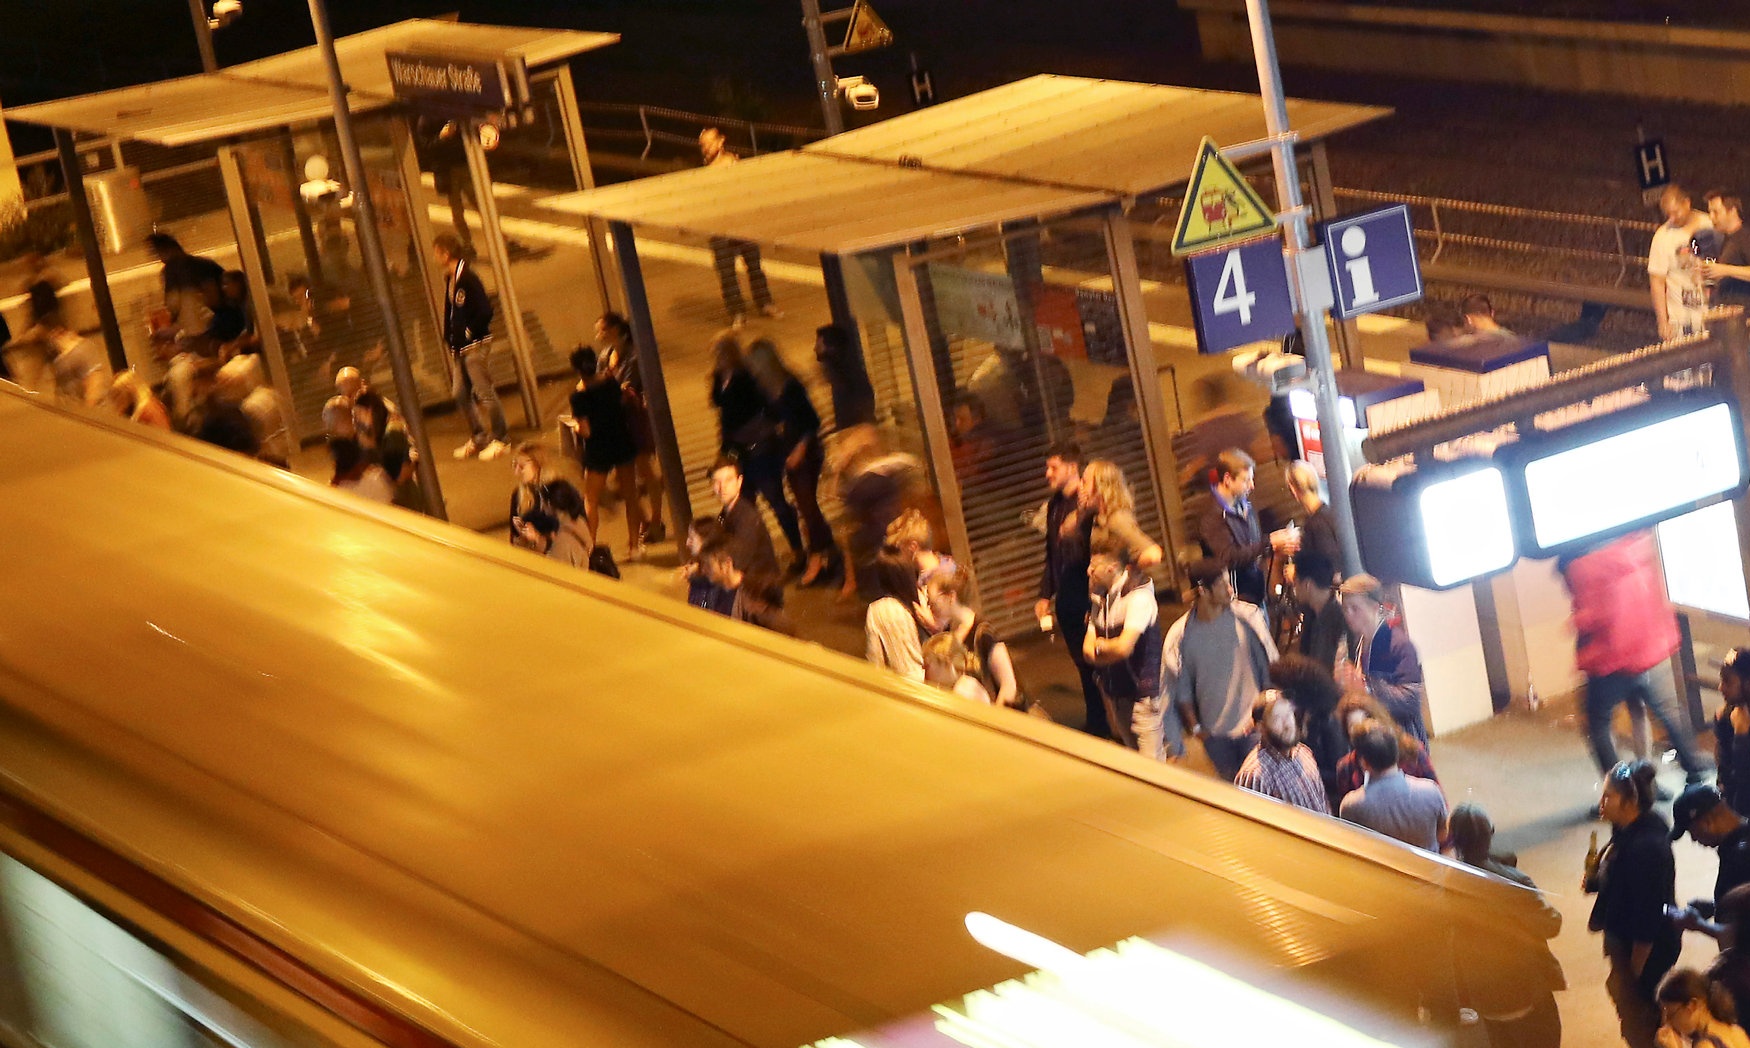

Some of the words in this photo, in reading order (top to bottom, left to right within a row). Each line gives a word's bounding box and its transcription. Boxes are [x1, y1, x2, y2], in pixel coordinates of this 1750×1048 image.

[391, 57, 448, 88] Warschauer
[447, 62, 482, 96] Straße
[912, 70, 934, 103] H
[1640, 143, 1665, 184] H
[1213, 248, 1256, 326] 4
